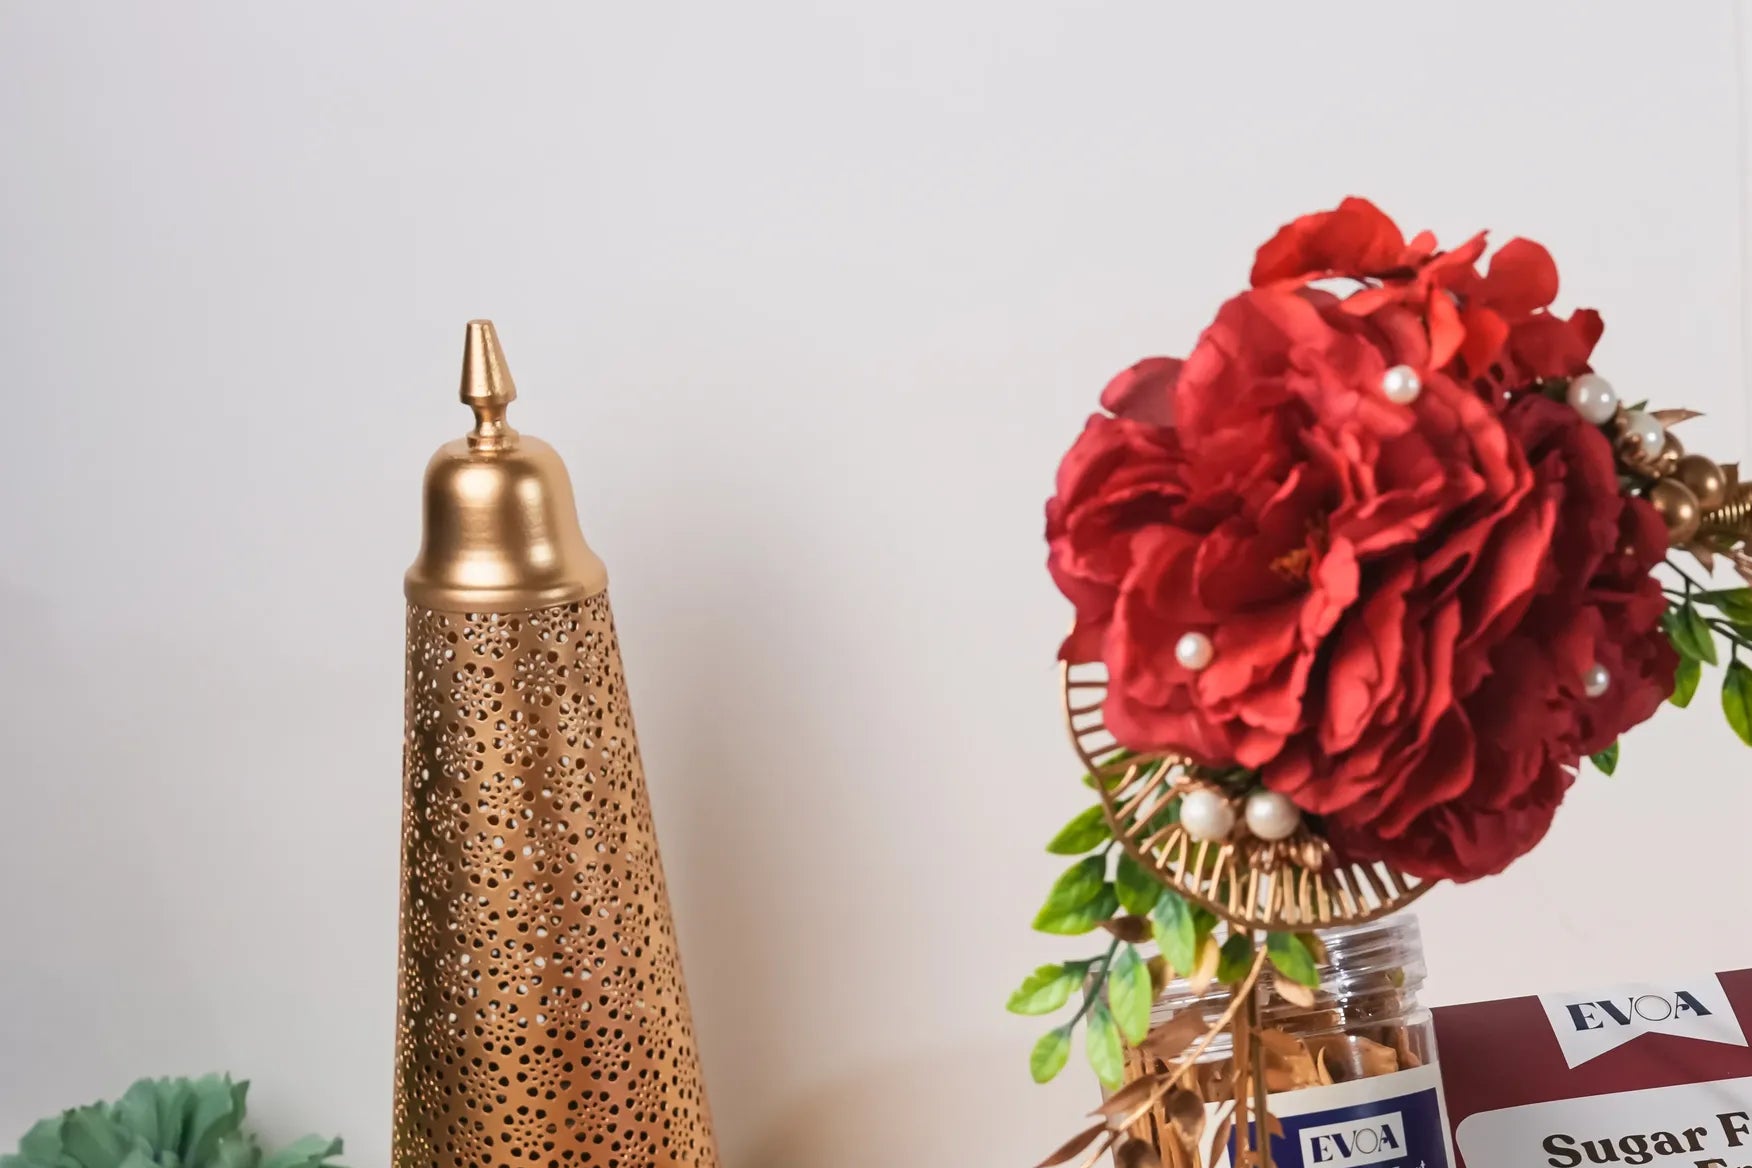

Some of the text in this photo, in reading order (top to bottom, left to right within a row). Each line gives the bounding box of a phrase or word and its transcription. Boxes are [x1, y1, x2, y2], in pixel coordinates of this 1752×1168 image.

[1565, 990, 1713, 1031] EVOA
[1310, 1123, 1400, 1164] EVOA
[1542, 1124, 1708, 1168] Sugar
